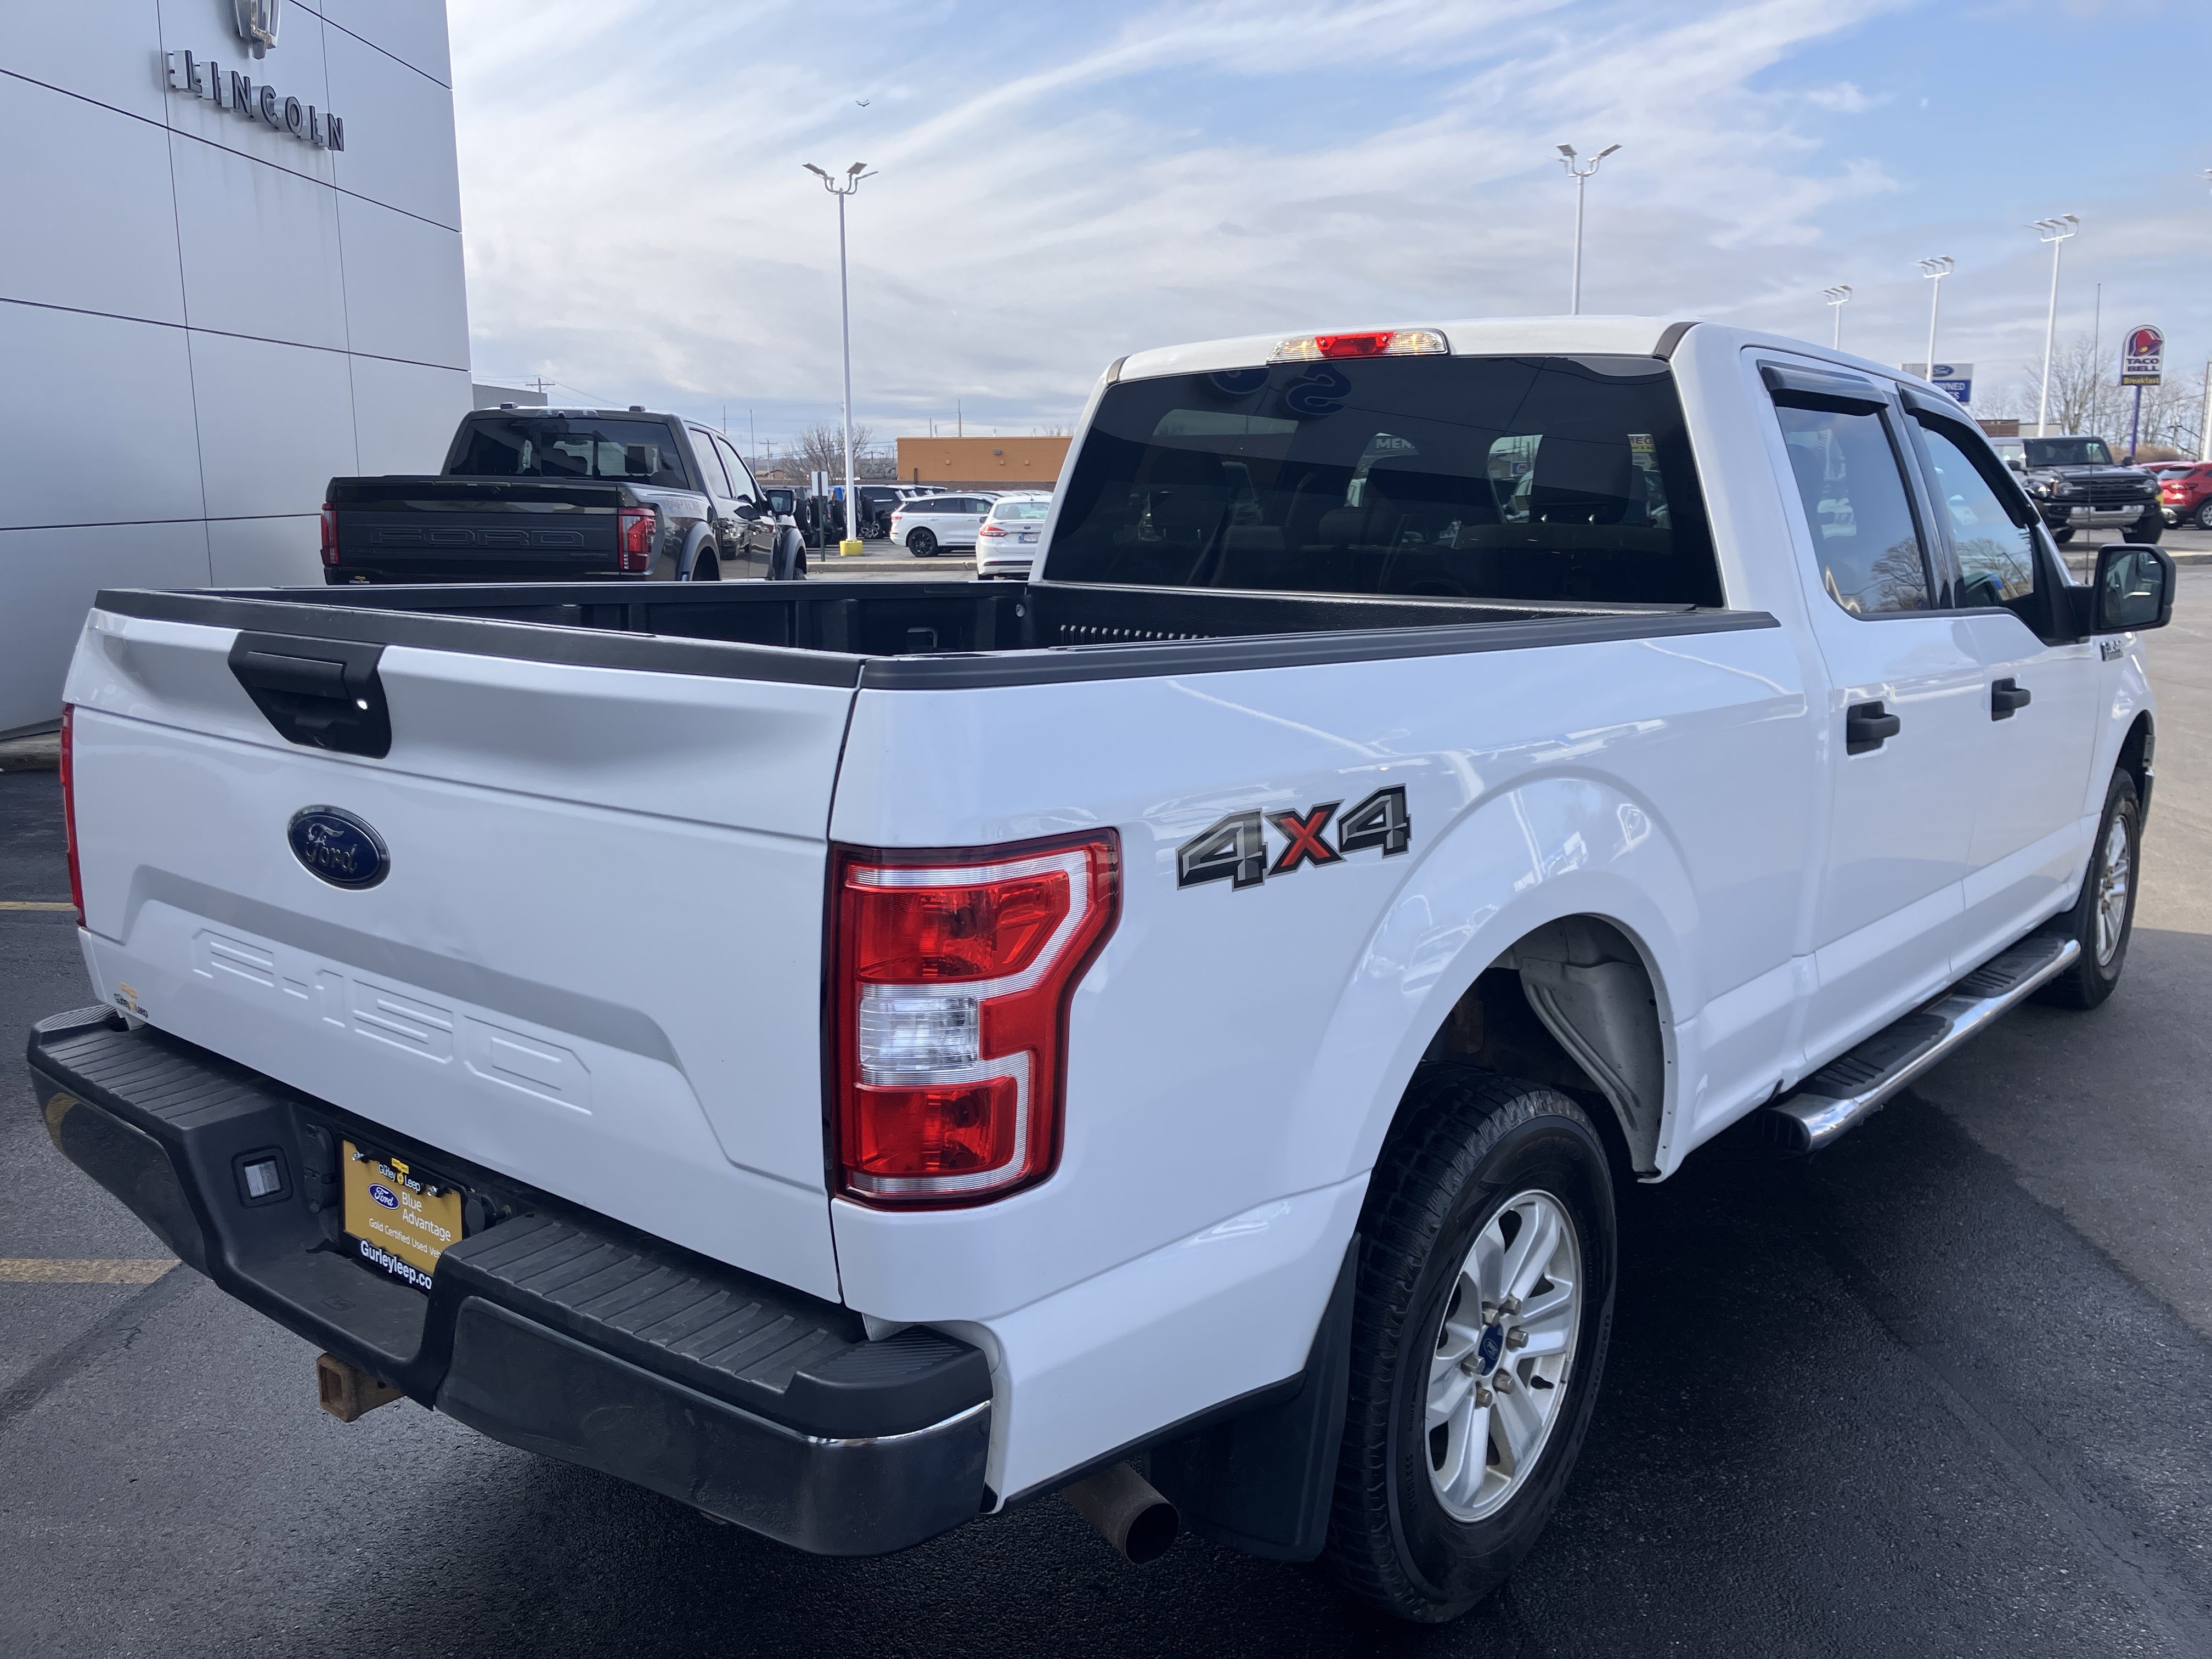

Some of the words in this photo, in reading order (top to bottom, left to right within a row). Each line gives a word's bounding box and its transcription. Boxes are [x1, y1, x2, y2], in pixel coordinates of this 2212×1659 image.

[173, 49, 344, 151] LINCOLN
[1376, 438, 1415, 449] MEN
[370, 528, 585, 548] FORD
[192, 928, 592, 1115] F-150
[404, 1175, 421, 1192] Leep
[402, 1191, 422, 1211] Blue
[369, 1218, 383, 1232] Gold
[385, 1225, 410, 1245] Certified
[412, 1237, 428, 1253] Used
[402, 1208, 452, 1242] Advantage
